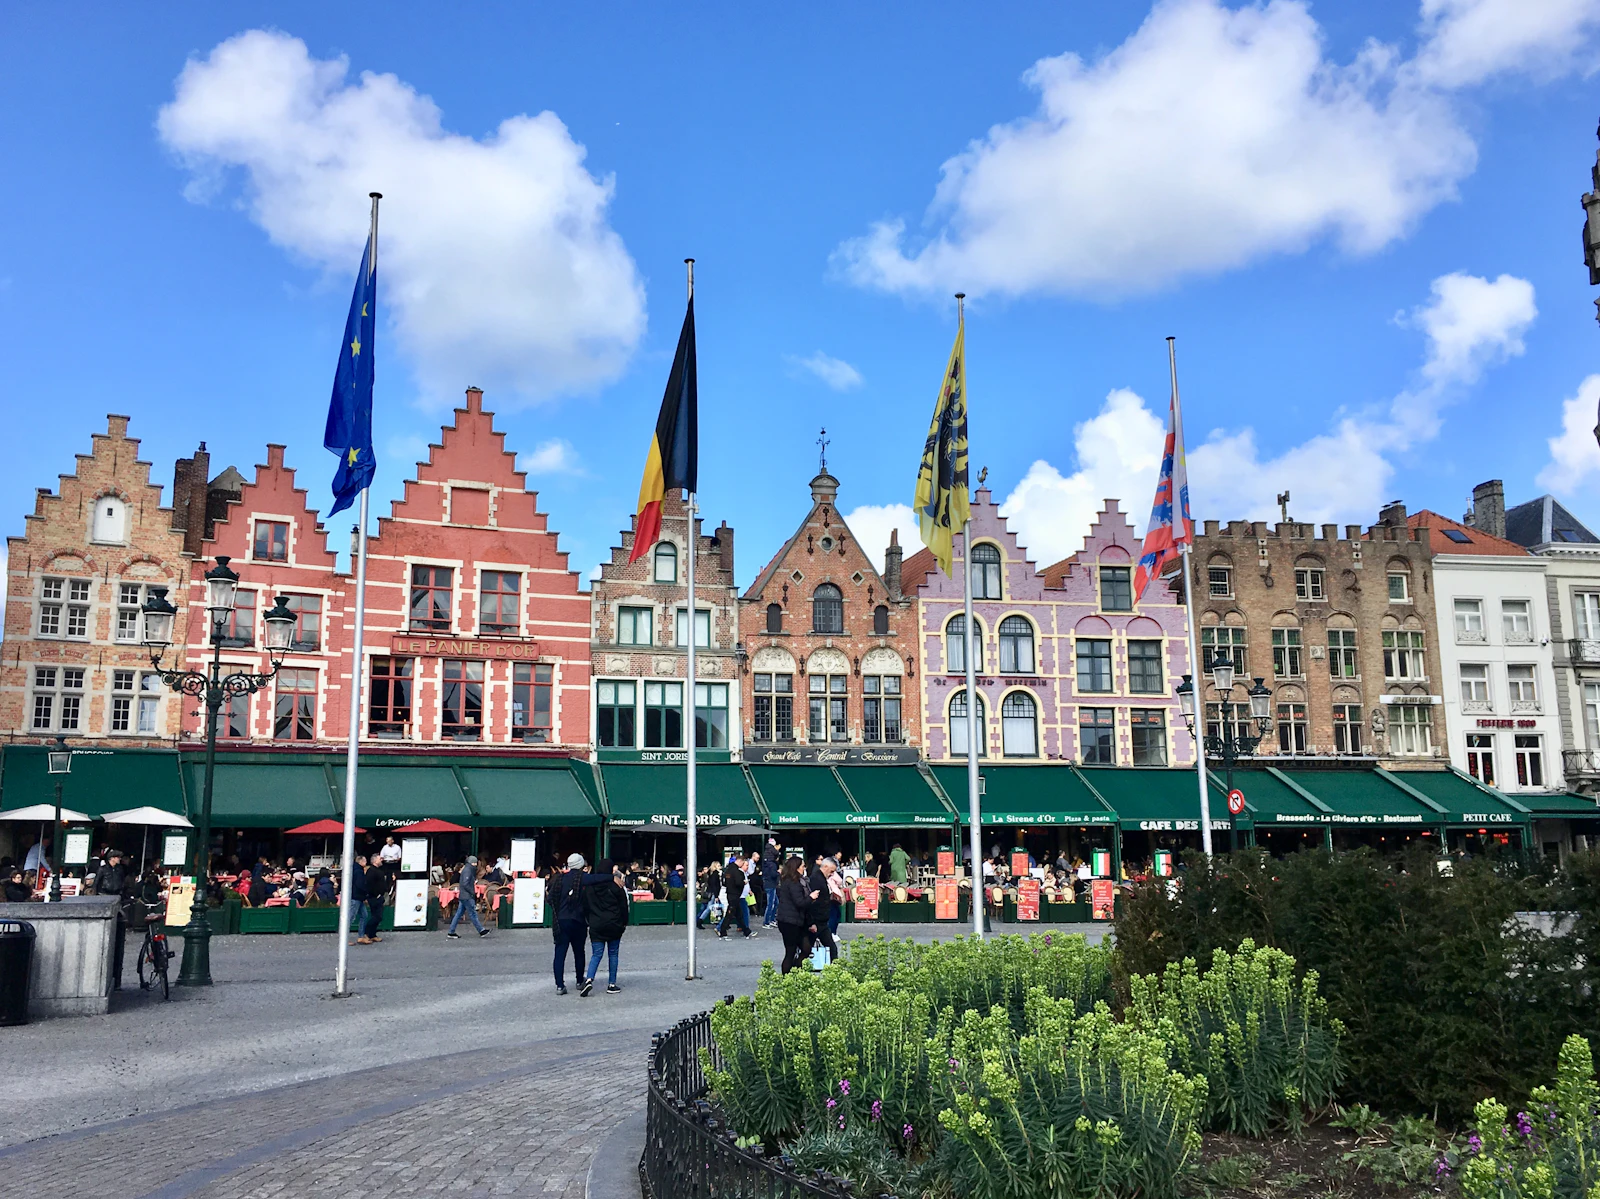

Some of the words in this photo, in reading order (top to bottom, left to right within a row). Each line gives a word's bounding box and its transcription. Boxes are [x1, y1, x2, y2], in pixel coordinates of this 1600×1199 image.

[398, 640, 421, 653] LE
[425, 639, 491, 655] PANIER
[641, 752, 662, 760] SINT
[664, 752, 689, 760] JORIS
[861, 751, 898, 761] Brasserie
[375, 818, 386, 827] Le
[779, 815, 799, 823] Hotel
[845, 814, 880, 823] Central
[992, 815, 1004, 823] La
[1006, 815, 1035, 823] Sirene
[1037, 814, 1056, 822] d'Or
[1092, 815, 1110, 823] pasta
[1463, 814, 1488, 822] PETIT
[1489, 814, 1512, 822] CAFE
[1139, 820, 1172, 830] CAFE
[1175, 821, 1198, 830] DES
